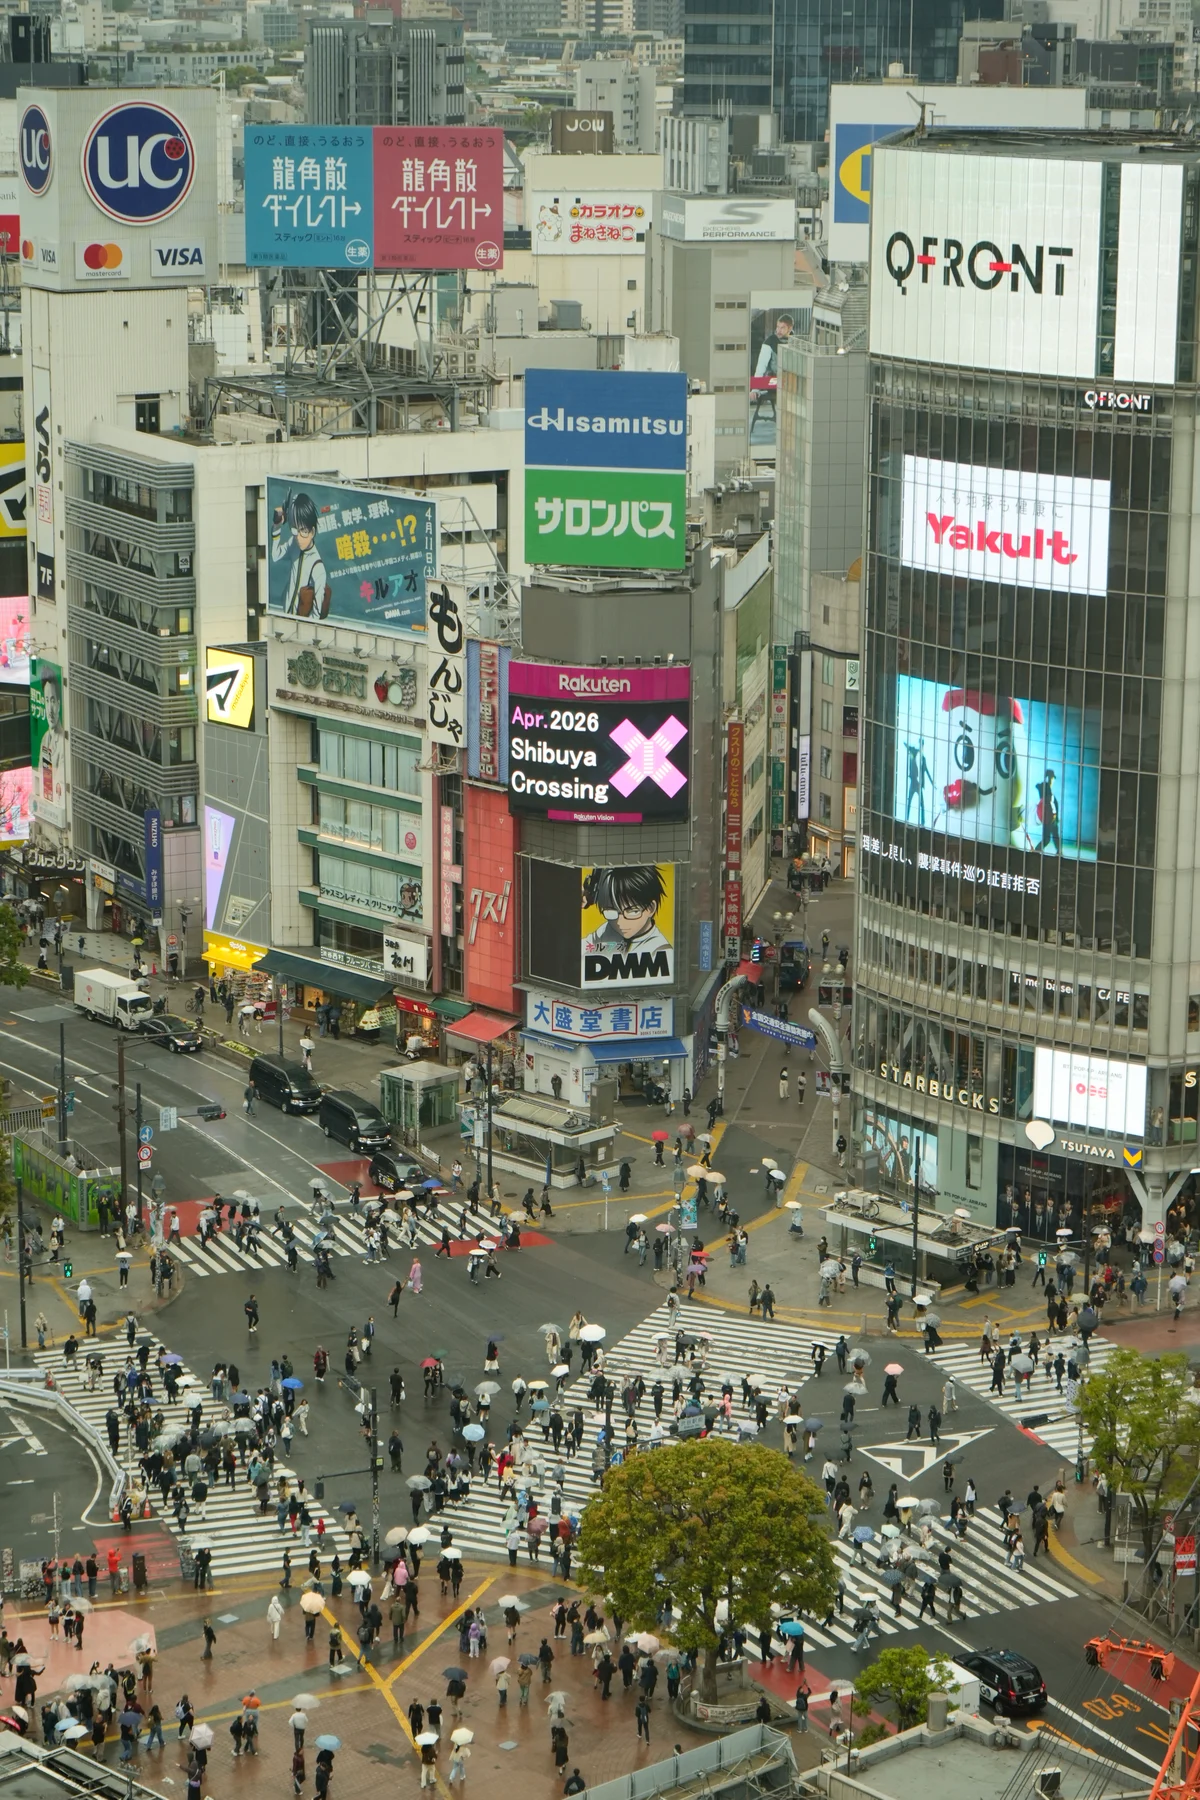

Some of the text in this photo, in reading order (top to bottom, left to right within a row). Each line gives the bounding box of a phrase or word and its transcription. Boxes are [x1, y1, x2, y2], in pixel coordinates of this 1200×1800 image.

[566, 119, 604, 132] JOW
[23, 127, 49, 171] UC
[254, 135, 365, 148] のど、直接、うるおう
[383, 136, 495, 149] のど、直接、うるおう
[97, 133, 184, 189] UC
[273, 156, 347, 191] 龍角散
[402, 158, 478, 193] 龍角散
[0, 191, 16, 201] ank
[262, 194, 362, 228] ダイレクト
[391, 196, 492, 230] ダイレクト
[579, 204, 635, 219] カラオケ
[274, 233, 313, 242] スティック
[403, 234, 442, 243] スティック
[570, 224, 636, 242] まねきねこ
[41, 247, 56, 264] VISA
[154, 247, 203, 267] VISA
[348, 246, 367, 258] 生薬
[477, 248, 497, 260] 生薬
[886, 232, 1073, 296] QFRONT
[85, 269, 122, 277] mastercard
[1084, 390, 1150, 411] QFRONT
[527, 407, 683, 436] Hisamitsu
[534, 497, 676, 540] サロンパス
[926, 512, 1078, 565] Yakult
[40, 567, 52, 586] 7F
[360, 569, 418, 603] キルアオ
[428, 584, 463, 743] もんじゃ
[231, 674, 250, 711] matsukiyo
[323, 667, 368, 700] 西村
[559, 674, 631, 697] Rakuten
[480, 648, 495, 776] 三千里薬品
[511, 706, 599, 732] Apr. 2026
[511, 737, 597, 770] Shibuya
[729, 727, 741, 808] クスリのことなら
[511, 771, 609, 804] Crossing
[573, 813, 596, 821] Rakuten
[728, 813, 740, 864] 三千里
[28, 848, 85, 872] グルメタウン
[468, 881, 512, 945] クスリ
[726, 893, 738, 936] 七輪焼肉
[321, 950, 344, 963] 渋谷西村
[385, 939, 400, 950] うなぎ
[585, 941, 628, 954] キルアオ
[727, 937, 738, 959] 牛繁
[391, 952, 414, 973] 松川
[584, 950, 670, 982] DMM
[1097, 990, 1130, 1004] CAFE
[534, 1000, 663, 1033] 大盛堂書店
[880, 1062, 1000, 1114] STARBUCKS
[1060, 1139, 1116, 1160] TSUTAYA
